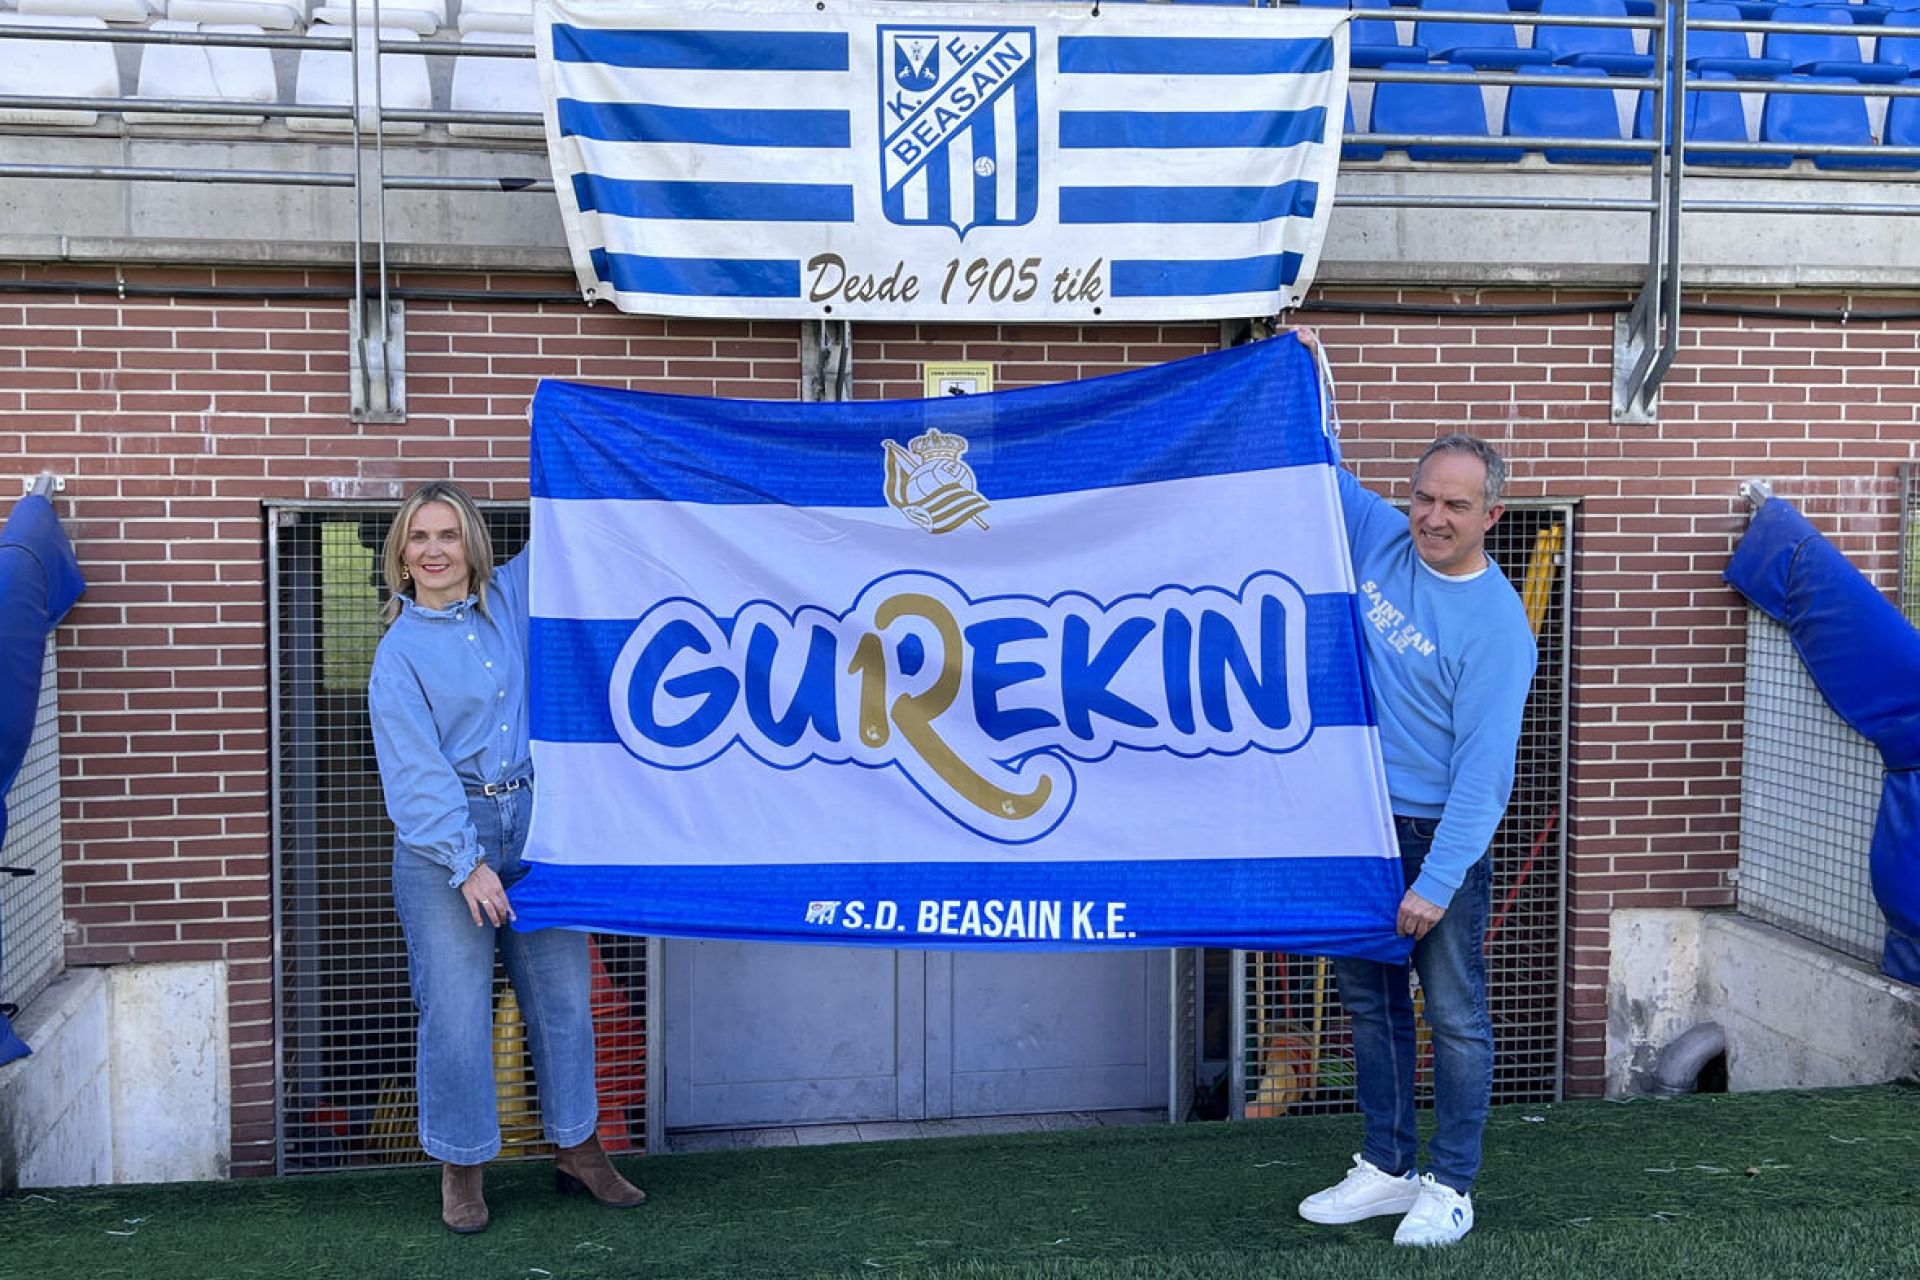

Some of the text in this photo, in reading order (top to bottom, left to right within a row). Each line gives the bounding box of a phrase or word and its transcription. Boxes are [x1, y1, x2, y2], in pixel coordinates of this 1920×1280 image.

[886, 36, 980, 121] K. E.
[892, 41, 1024, 166] BEASAIN
[807, 252, 1103, 304] Desde 1905 tik
[1361, 580, 1436, 657] SAINT EAN
[1366, 607, 1391, 633] DE
[627, 593, 1292, 821] GUREKIN
[842, 900, 905, 931] S.D.
[917, 900, 1061, 938] BEASAIN
[1072, 901, 1137, 939] K.E.
